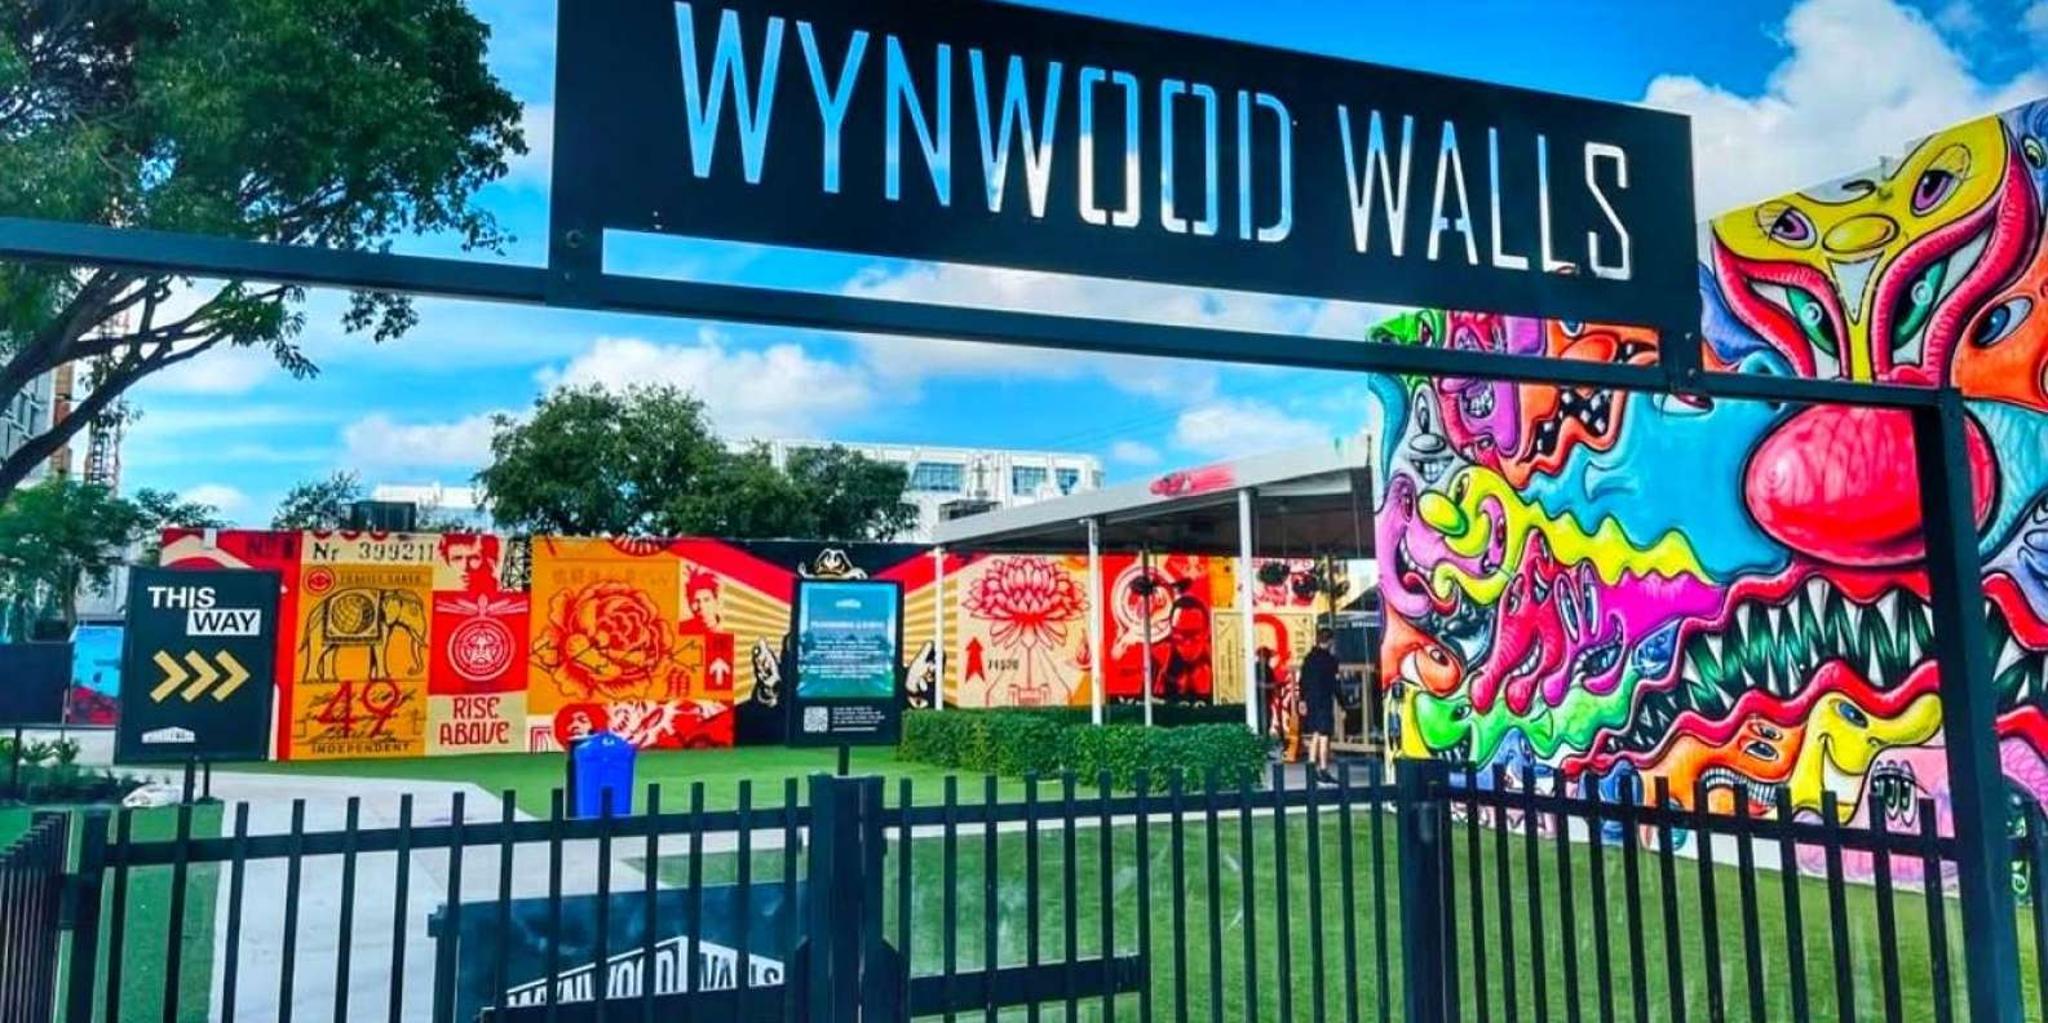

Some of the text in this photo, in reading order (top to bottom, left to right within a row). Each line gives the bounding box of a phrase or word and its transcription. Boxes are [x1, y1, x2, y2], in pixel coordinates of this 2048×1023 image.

[674, 1, 1631, 281] WYNWOOD WALLS
[147, 586, 216, 609] THIS
[194, 612, 256, 632] WAY
[316, 680, 398, 738] 49
[453, 697, 500, 719] RISE
[440, 721, 509, 745] ABOVE
[311, 741, 410, 756] INDEPENDENT
